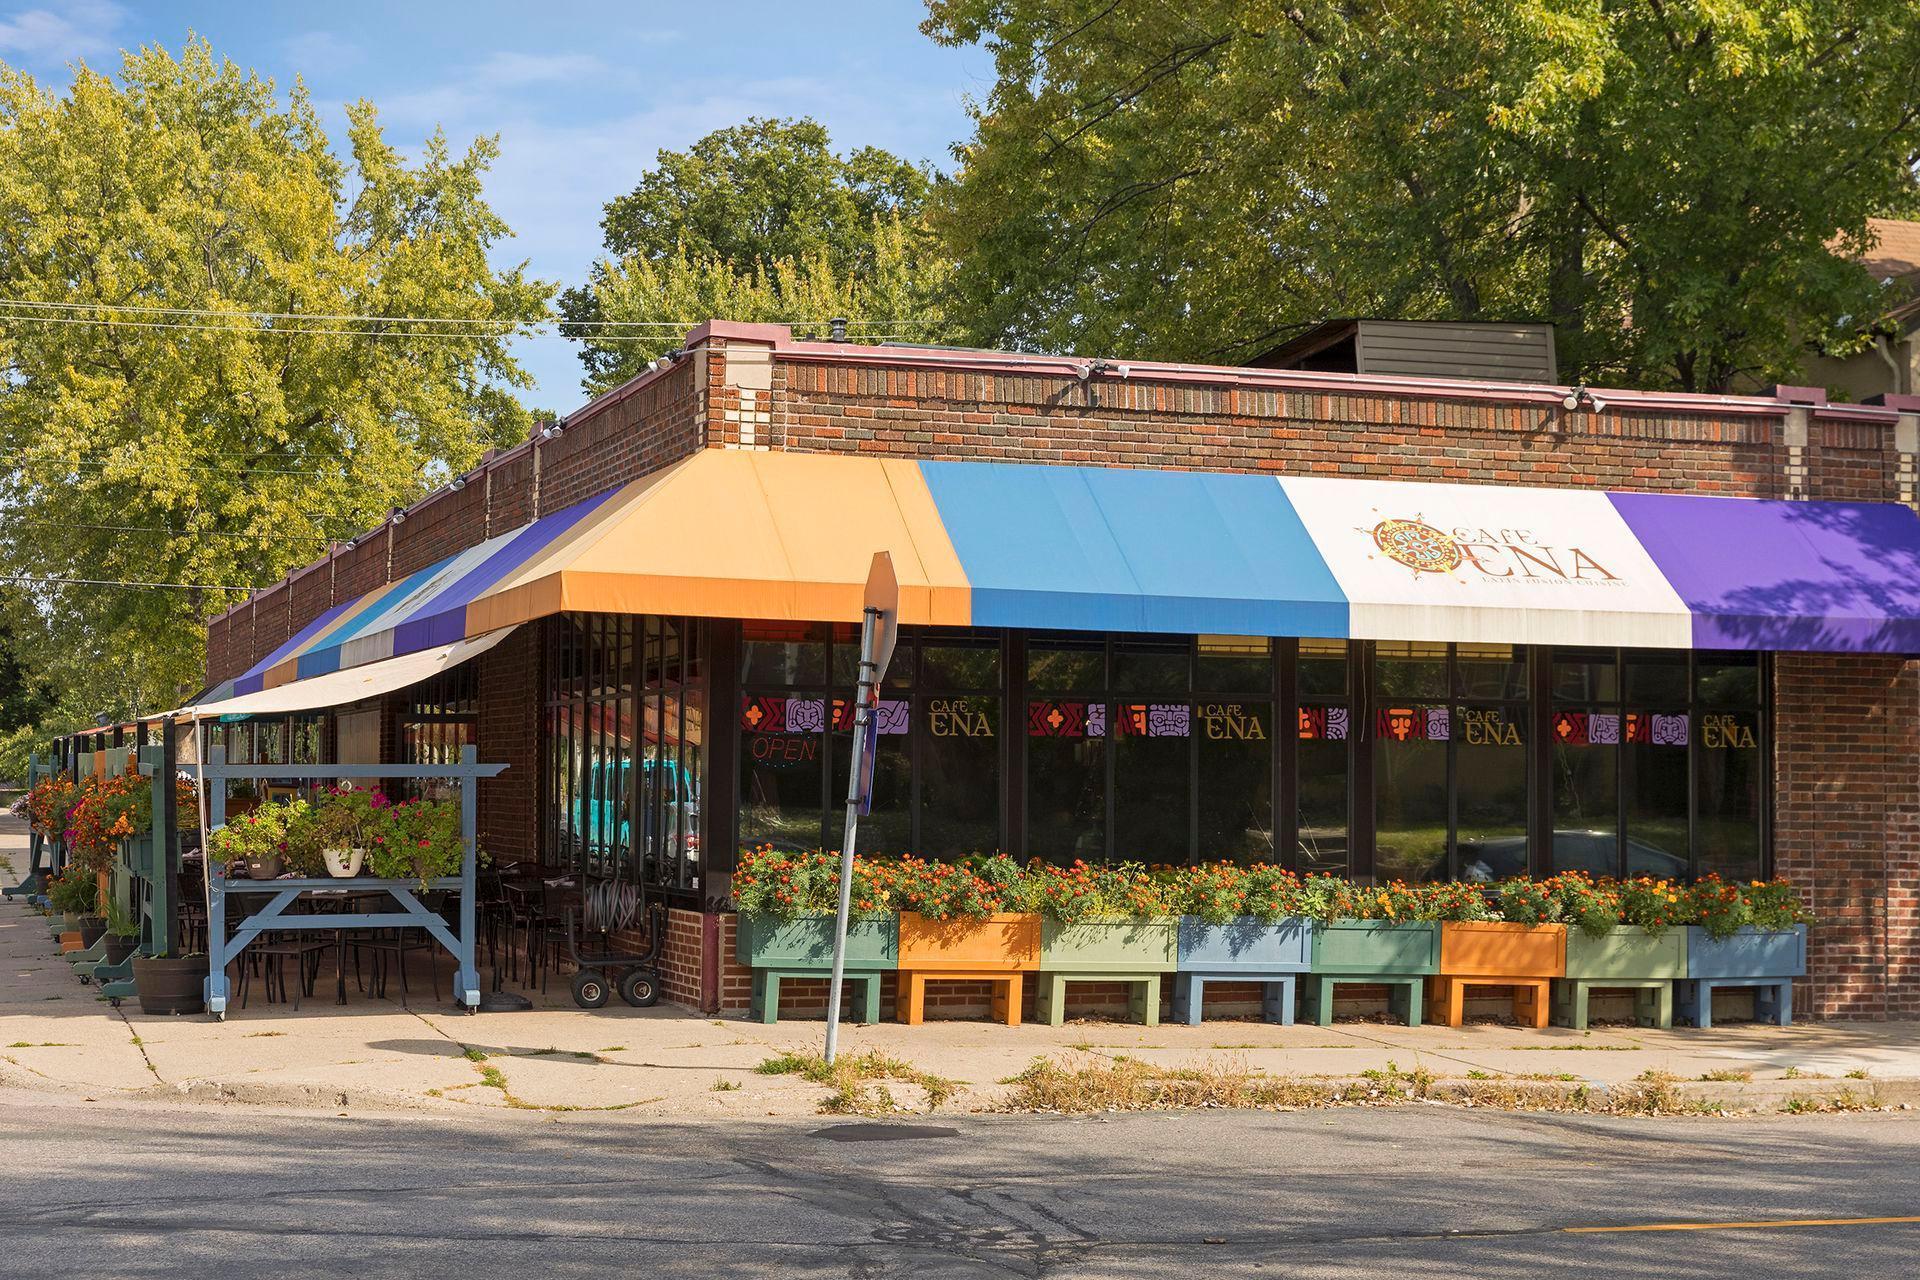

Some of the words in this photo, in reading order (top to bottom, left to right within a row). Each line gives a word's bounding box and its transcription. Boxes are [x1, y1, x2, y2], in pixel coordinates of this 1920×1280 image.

[1458, 544, 1623, 580] ENA
[928, 712, 994, 736] ENA
[1205, 716, 1266, 740] ENA
[1464, 722, 1523, 746] ENA
[752, 737, 817, 760] OPEN
[1702, 725, 1757, 748] ENA
